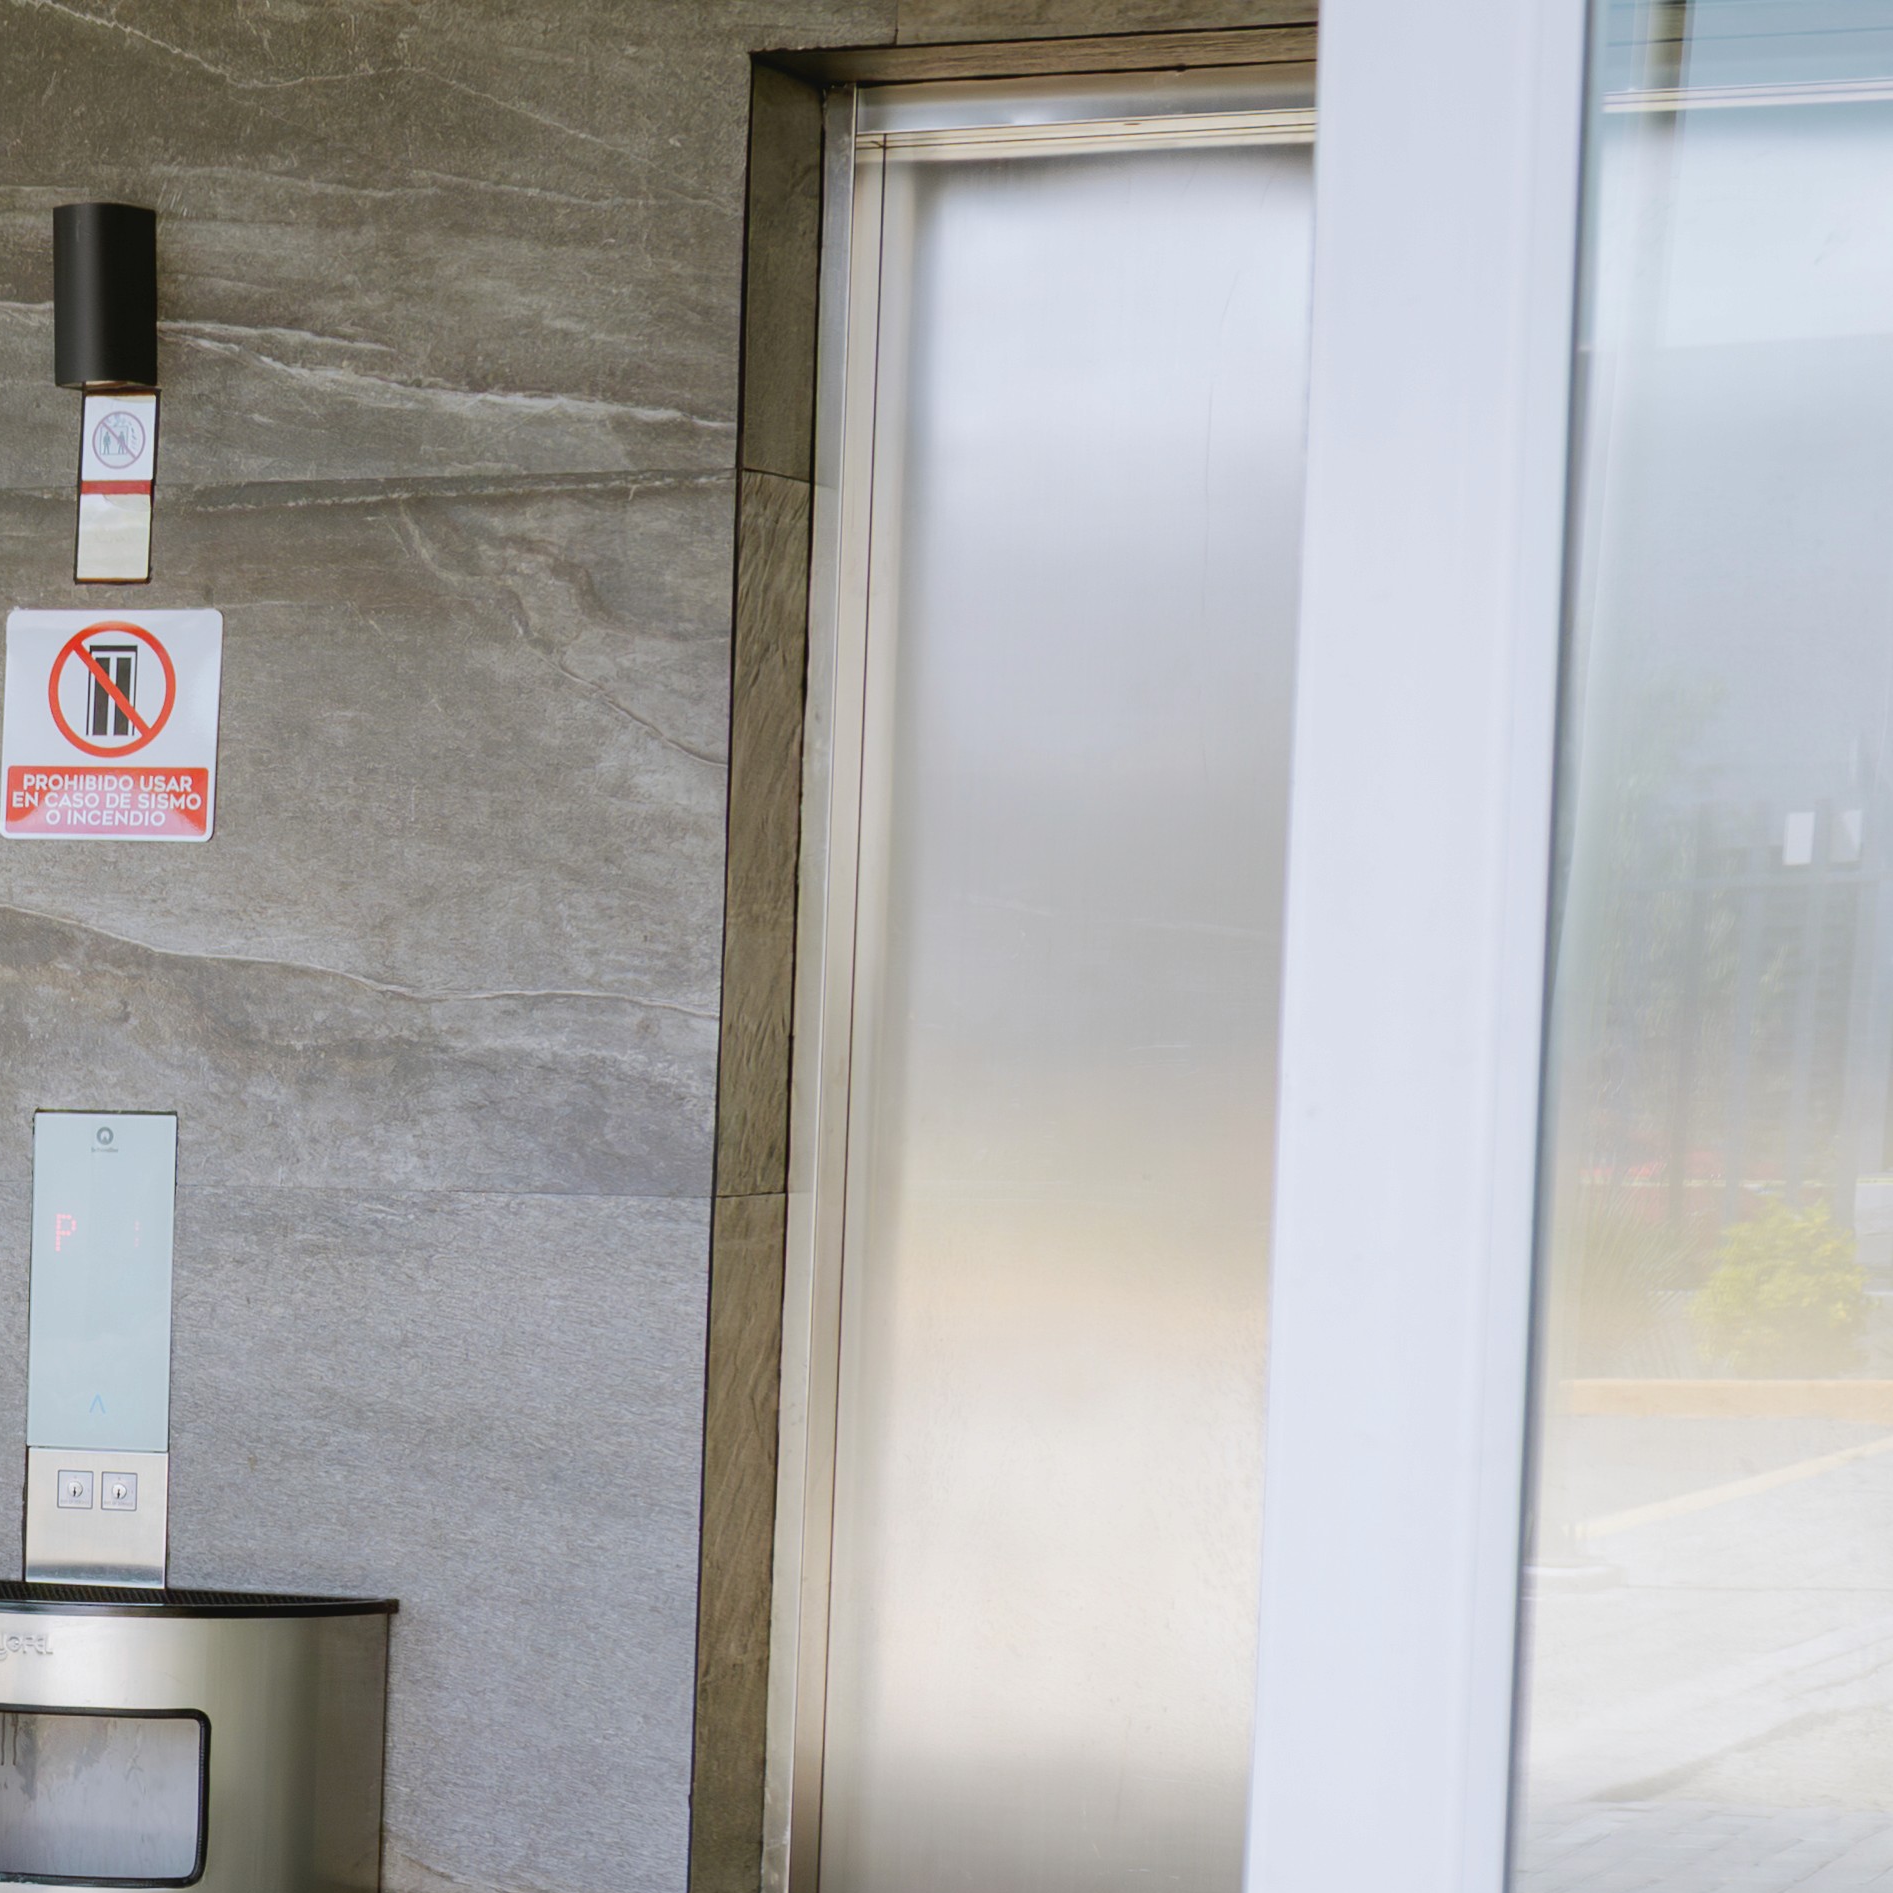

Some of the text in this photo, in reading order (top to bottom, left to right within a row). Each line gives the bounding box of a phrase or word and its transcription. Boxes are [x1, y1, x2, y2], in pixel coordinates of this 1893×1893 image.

[23, 774, 193, 793] PROHIBIDO USAR
[12, 792, 202, 810] EN CASO DE SISMO
[45, 809, 166, 827] O INCENDIO
